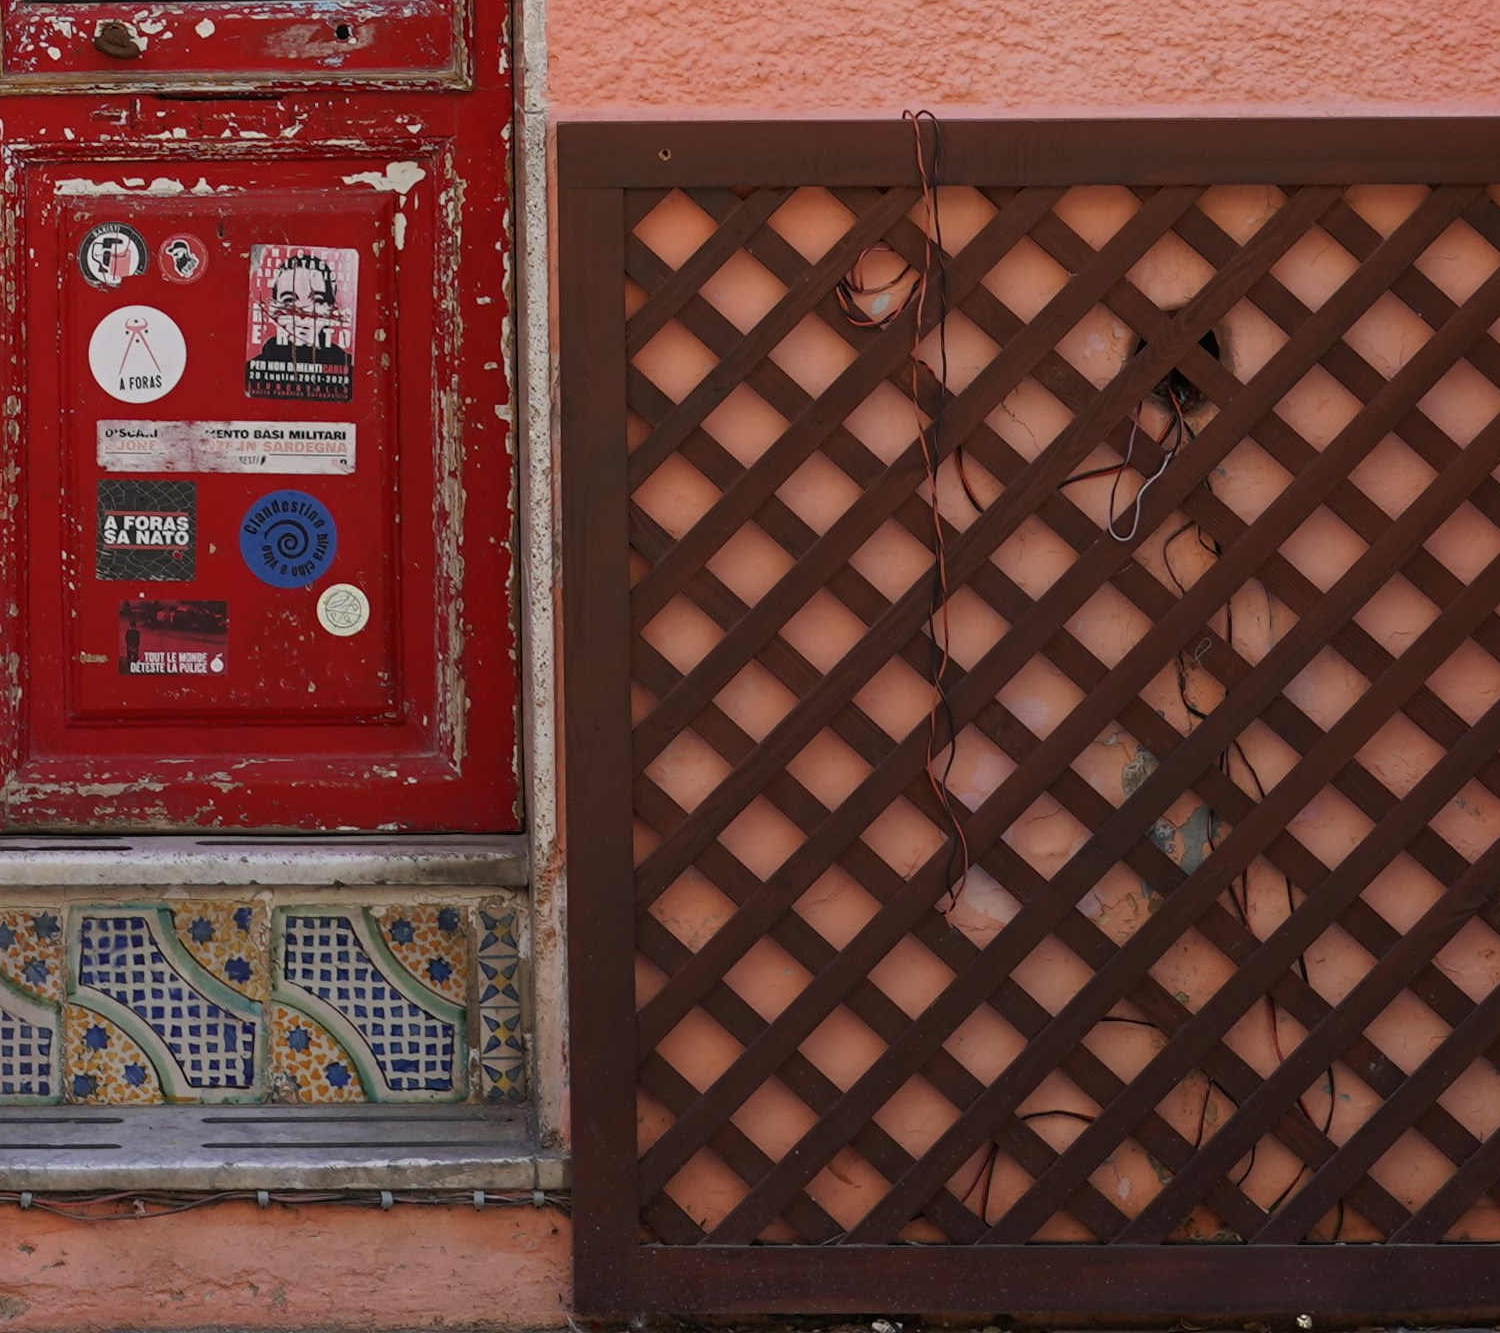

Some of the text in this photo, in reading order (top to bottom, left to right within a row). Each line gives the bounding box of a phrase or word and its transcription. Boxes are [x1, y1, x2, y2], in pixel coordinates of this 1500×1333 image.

[250, 360, 286, 371] PER NON
[119, 375, 163, 391] A FORAS
[254, 429, 347, 440] BASI MILITARI
[263, 442, 348, 453] SARDEGNA
[104, 516, 190, 531] A FORAS
[243, 499, 325, 535] Clandestino
[103, 530, 190, 545] SA NATO
[261, 544, 277, 569] vino
[143, 652, 165, 662] TOUT
[167, 662, 177, 673] LA
